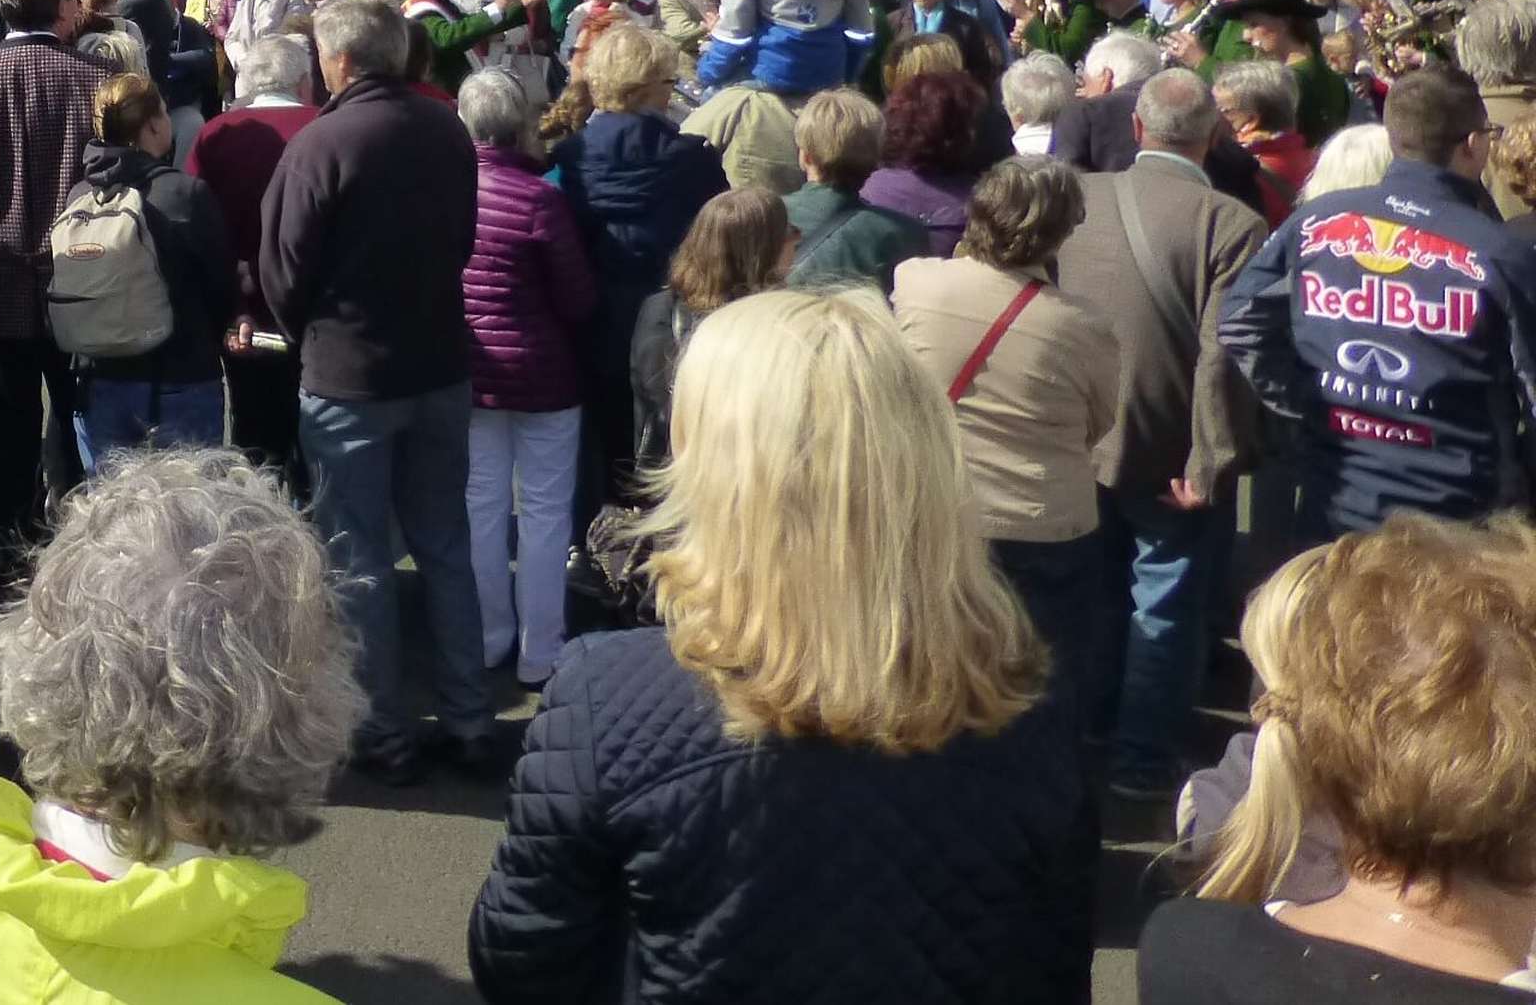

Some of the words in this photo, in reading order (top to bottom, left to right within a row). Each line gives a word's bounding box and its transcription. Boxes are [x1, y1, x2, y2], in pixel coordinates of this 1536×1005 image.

[1300, 271, 1379, 325] Red
[1382, 280, 1478, 337] Bull
[1320, 370, 1434, 410] INFINITI
[1334, 411, 1425, 442] TOTAL
